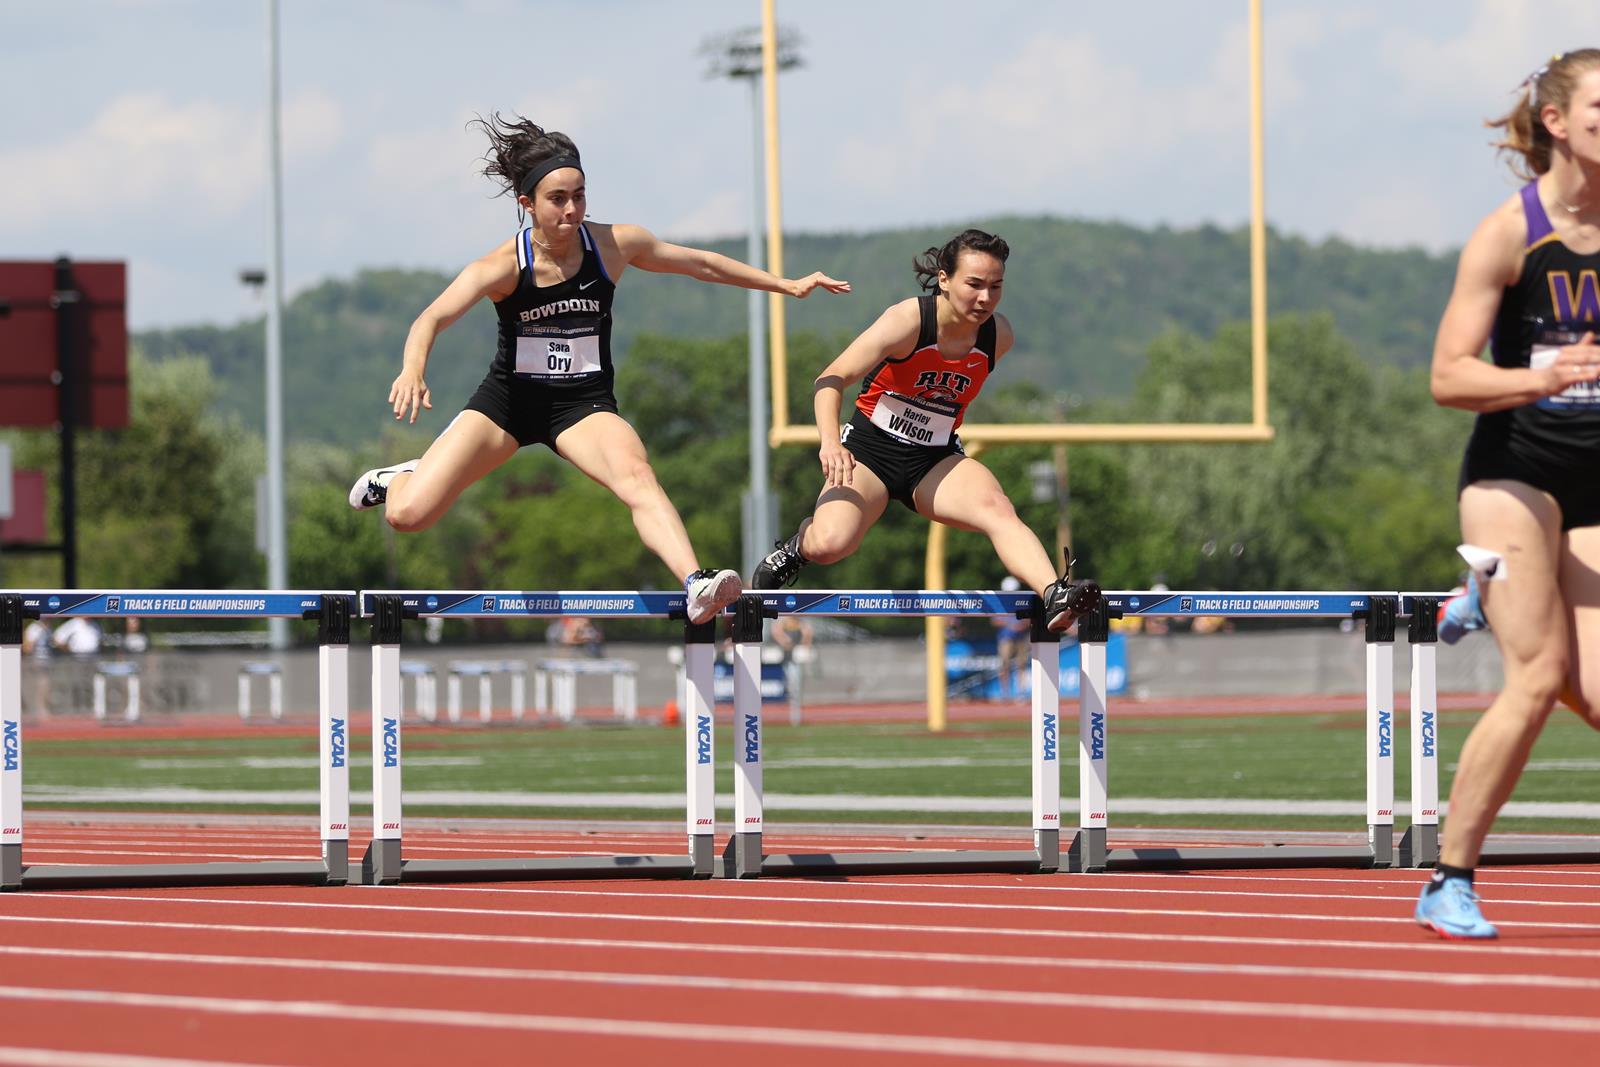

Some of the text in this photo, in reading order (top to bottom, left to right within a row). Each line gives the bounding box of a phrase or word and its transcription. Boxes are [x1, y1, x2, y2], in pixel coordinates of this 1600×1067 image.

[520, 299, 600, 322] BOWDOIN
[549, 342, 570, 352] Sara
[547, 355, 572, 372] Ory
[914, 371, 972, 393] RIT
[888, 414, 934, 443] Wilson
[903, 407, 931, 425] Harley
[124, 599, 266, 610] TRACK & FIELD CHAMPIONSHIPS
[499, 599, 634, 610] TRACK & FIELD CHAMPIONSHIPS
[854, 598, 983, 609] TRACK & FIELD CHAMPIONSHIPS
[1196, 599, 1319, 610] TRACK & FIELD CHAMPIONSHIPS
[4, 720, 18, 771] NCAA
[331, 718, 345, 768] NCAA
[383, 718, 397, 768] NCAA
[698, 715, 711, 764] NCAA
[745, 714, 758, 763] NCAA
[1043, 712, 1056, 760] NCAA
[1091, 712, 1104, 760] NCAA
[1379, 711, 1391, 757] NCAA
[1422, 711, 1434, 757] NCAA
